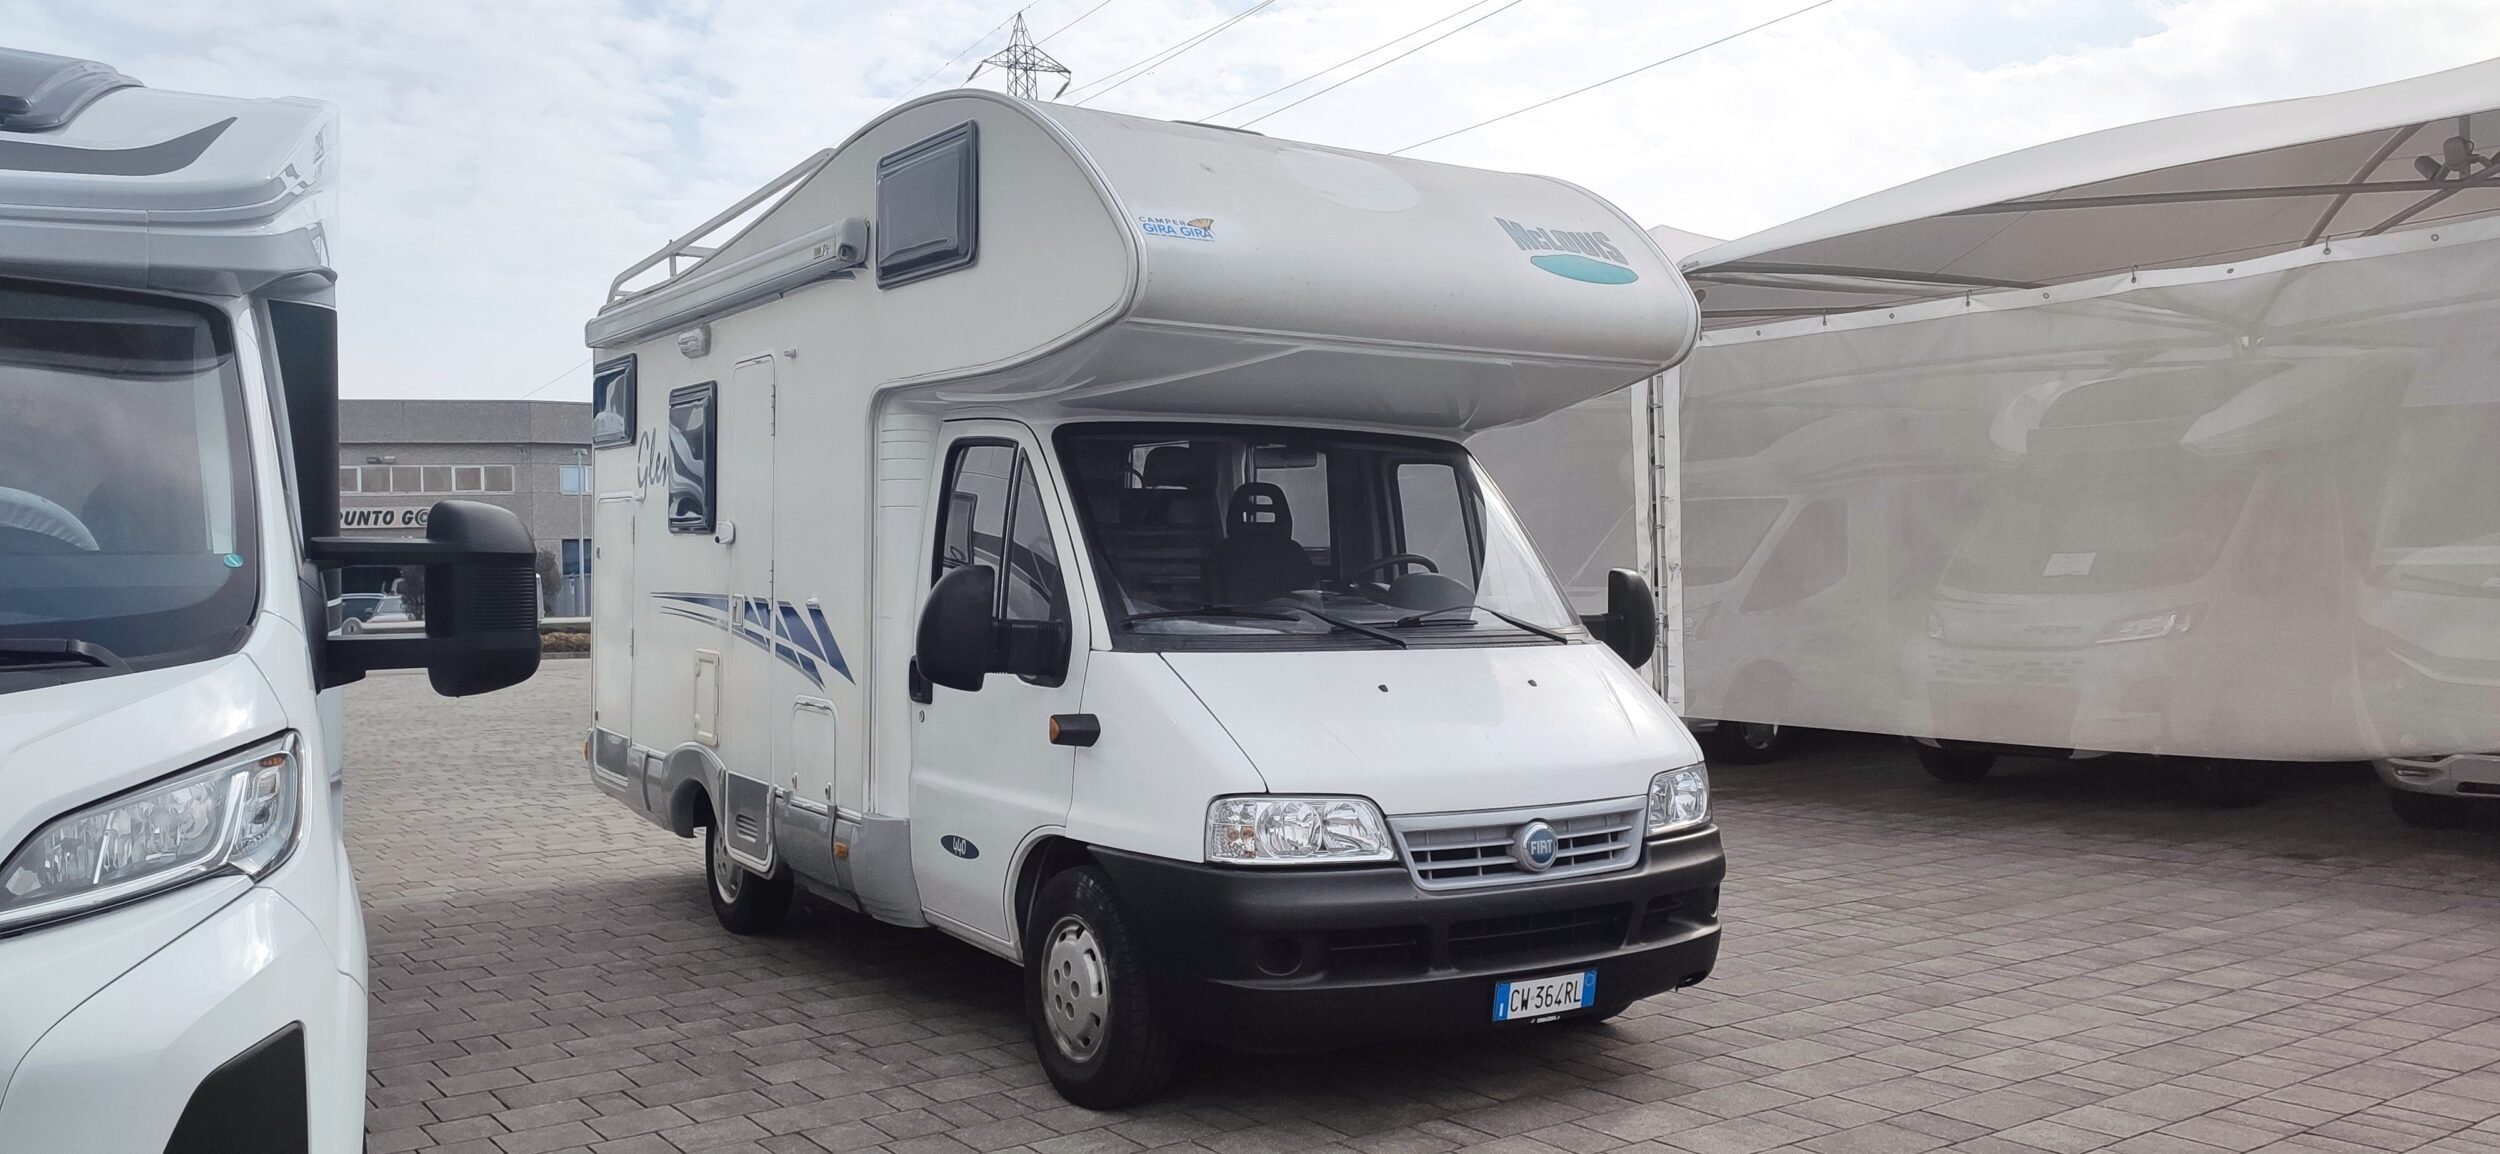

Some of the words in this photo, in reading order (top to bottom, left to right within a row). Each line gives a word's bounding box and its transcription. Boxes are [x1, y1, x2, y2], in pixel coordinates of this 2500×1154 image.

[1138, 216, 1187, 226] CAMPER
[1142, 223, 1177, 235] GIRA
[1180, 226, 1214, 239] GIRA
[340, 510, 395, 526] UNTO
[952, 836, 967, 857] 440
[1530, 839, 1553, 856] FIAT
[1510, 987, 1531, 1013] CW
[1534, 980, 1582, 1009] 364RL
